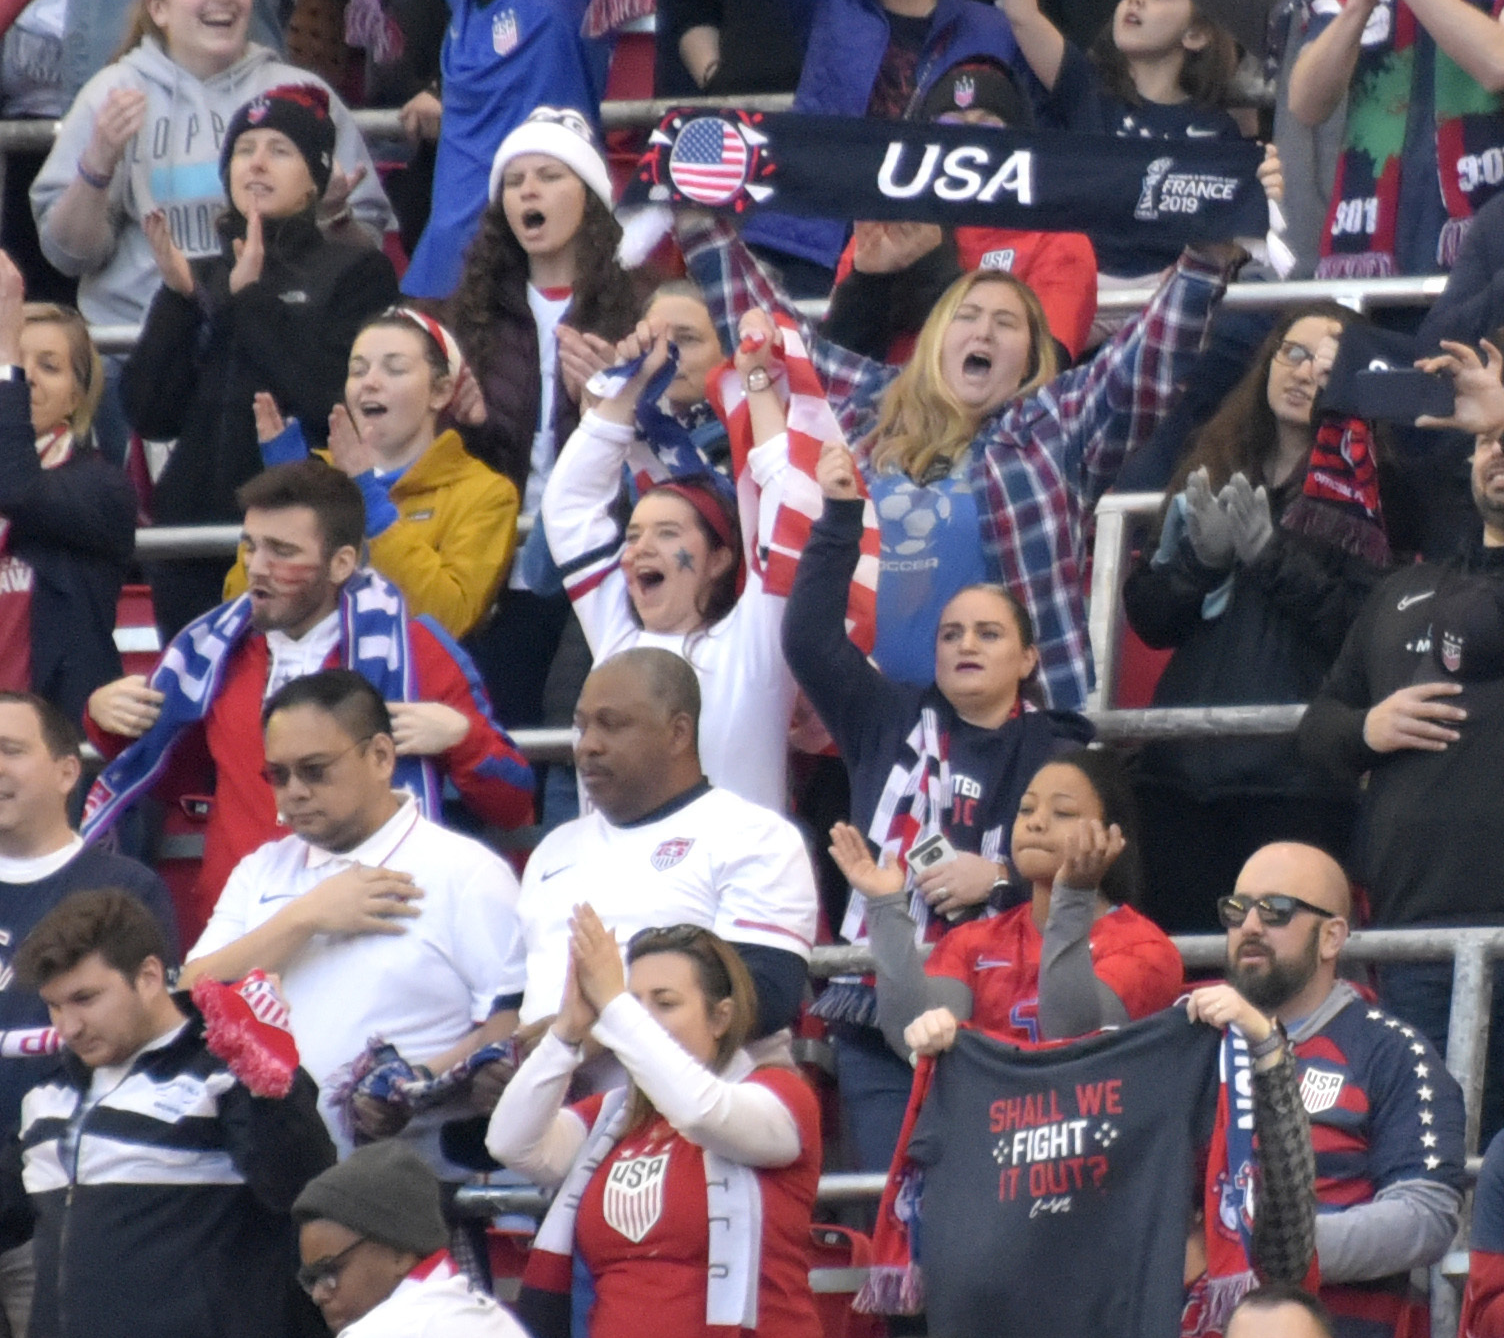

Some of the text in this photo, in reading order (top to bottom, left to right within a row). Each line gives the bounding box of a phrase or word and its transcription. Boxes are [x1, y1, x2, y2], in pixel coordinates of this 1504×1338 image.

[876, 141, 1035, 205] USA
[1162, 178, 1239, 203] FRANCE
[1158, 194, 1200, 214] 2019
[1306, 1071, 1341, 1092] USA
[989, 1079, 1124, 1129] SHALL WE
[1010, 1121, 1089, 1164] FIGHT
[611, 1157, 665, 1189] USA
[998, 1155, 1109, 1202] IT OUT?
